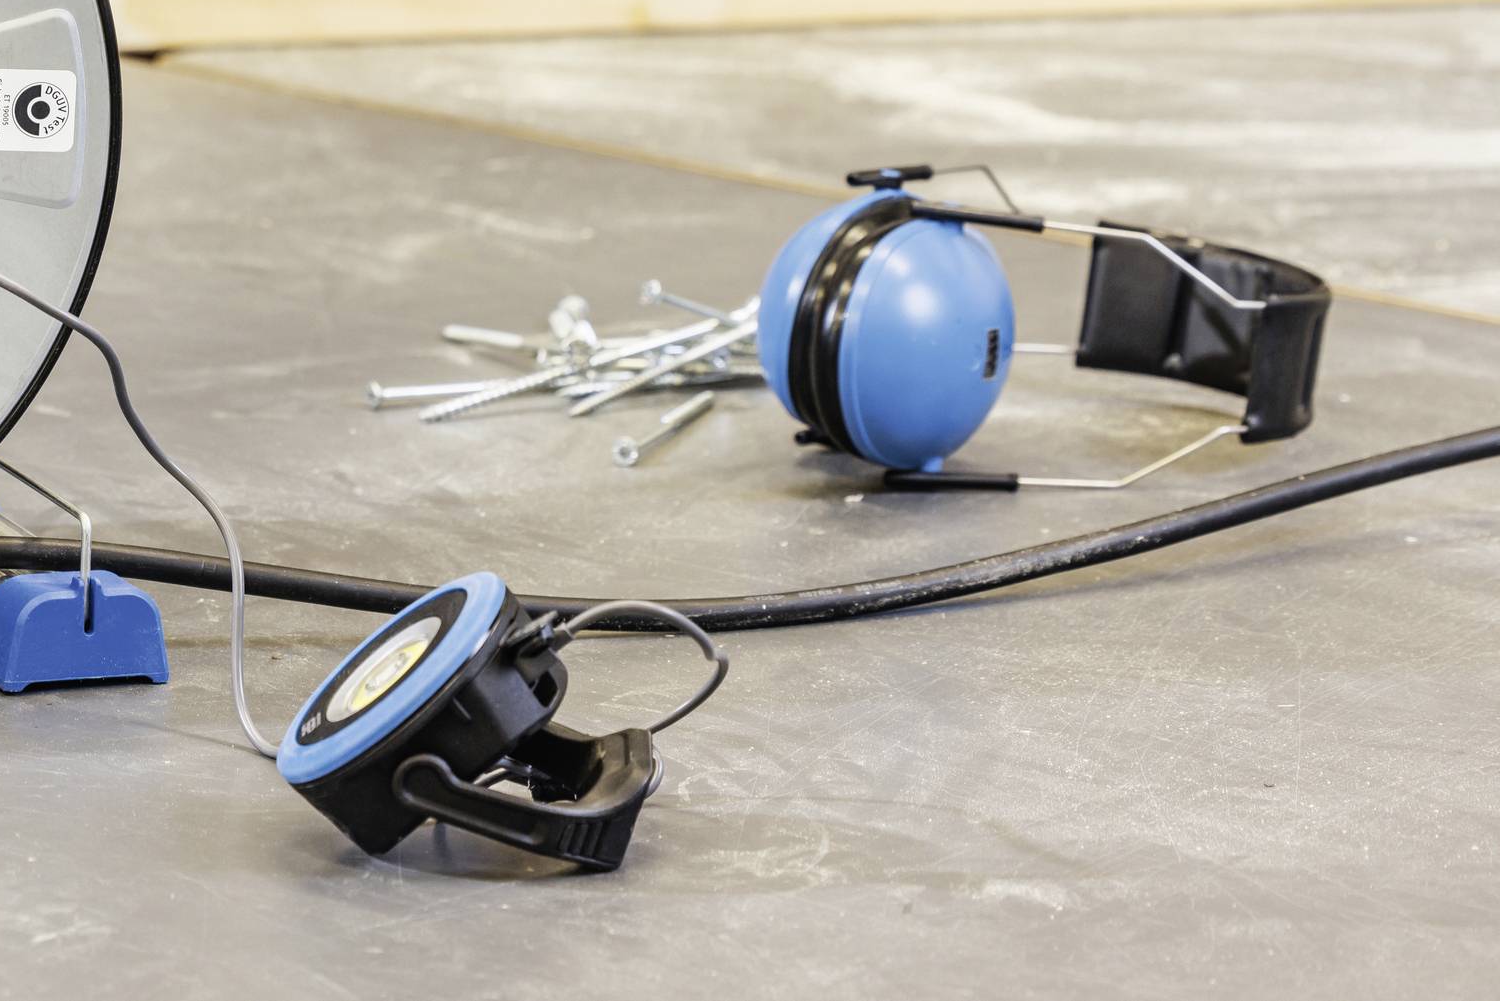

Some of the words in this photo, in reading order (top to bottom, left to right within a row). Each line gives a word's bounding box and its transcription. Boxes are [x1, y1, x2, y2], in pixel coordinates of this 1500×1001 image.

[4, 94, 11, 102] ET
[45, 85, 67, 113] DGUV
[2, 105, 11, 126] 19005
[43, 115, 66, 135] Test
